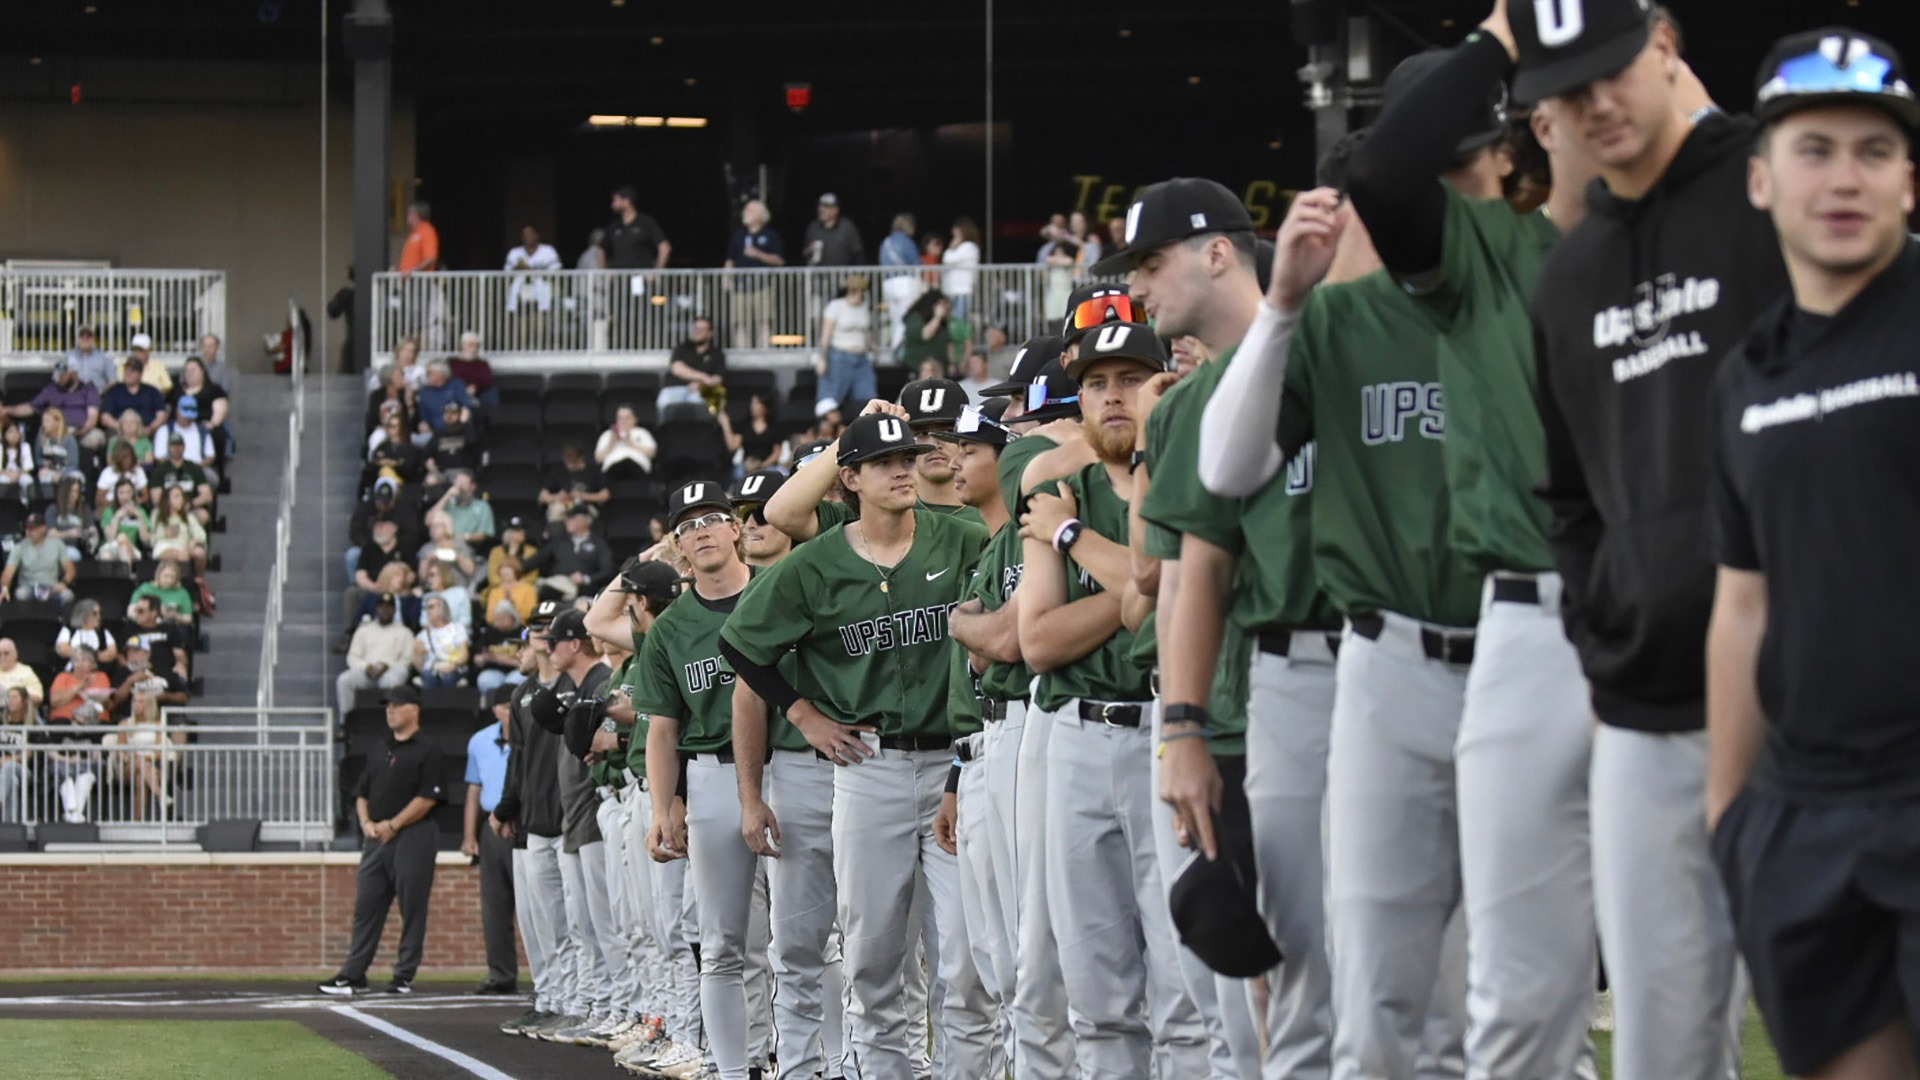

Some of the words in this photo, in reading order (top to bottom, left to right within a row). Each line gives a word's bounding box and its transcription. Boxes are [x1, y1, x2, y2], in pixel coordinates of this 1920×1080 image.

[1095, 326, 1132, 352] U
[919, 388, 945, 412] U
[878, 419, 902, 442] U
[683, 483, 705, 504] U
[741, 475, 765, 495] U
[538, 602, 555, 614] U
[839, 600, 959, 656] UPSTAT
